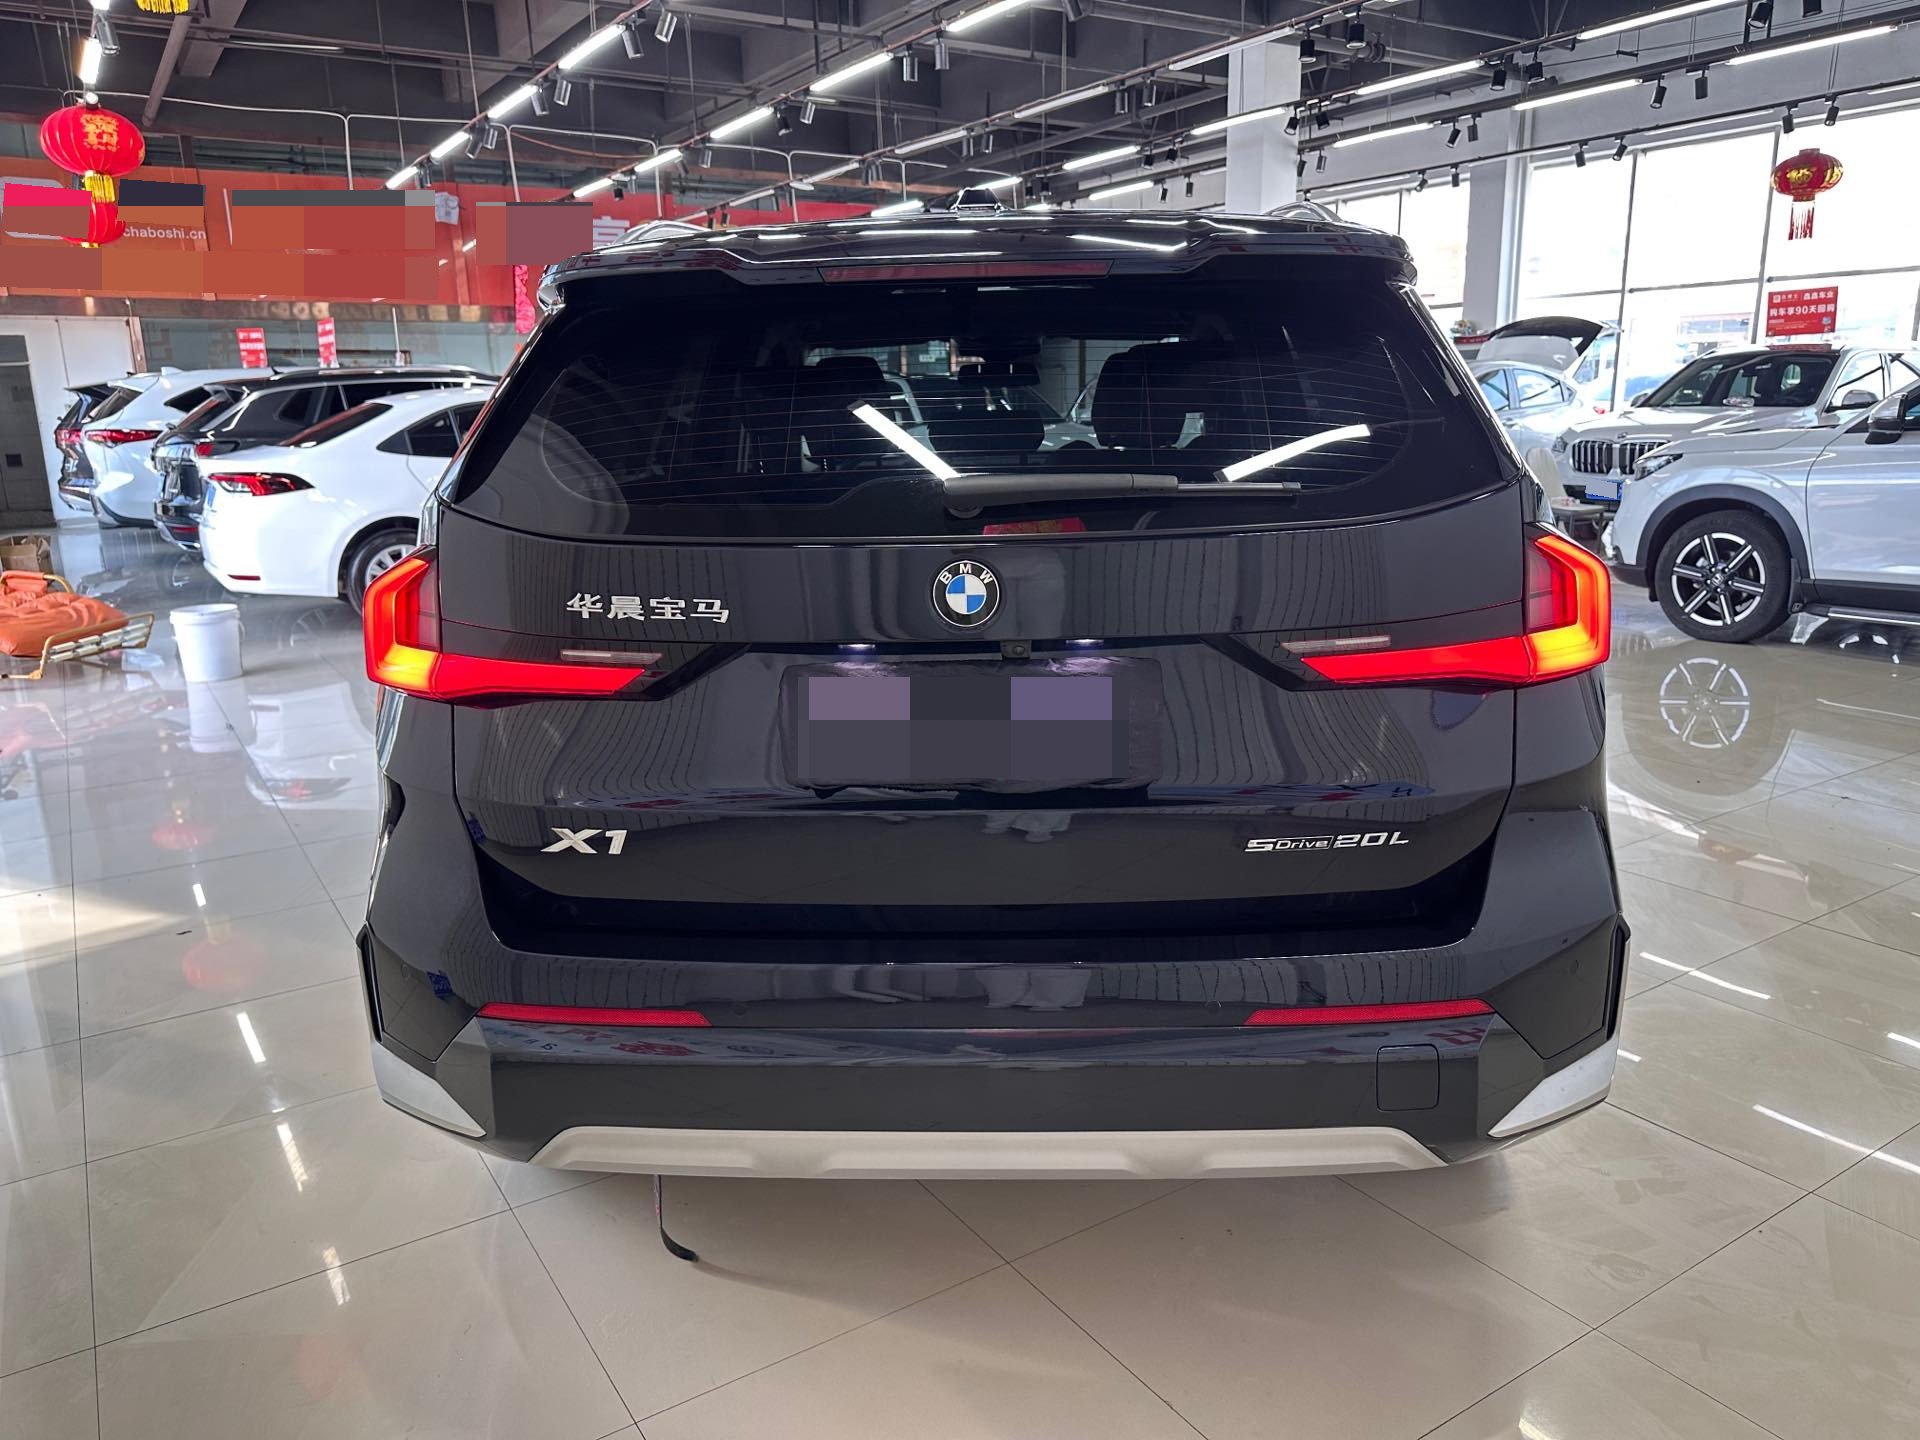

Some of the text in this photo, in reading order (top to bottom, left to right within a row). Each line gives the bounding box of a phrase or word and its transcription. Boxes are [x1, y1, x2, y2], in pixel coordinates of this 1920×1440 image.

[939, 563, 994, 585] BMW
[566, 592, 730, 624] 华晨宝马
[540, 827, 628, 855] X1
